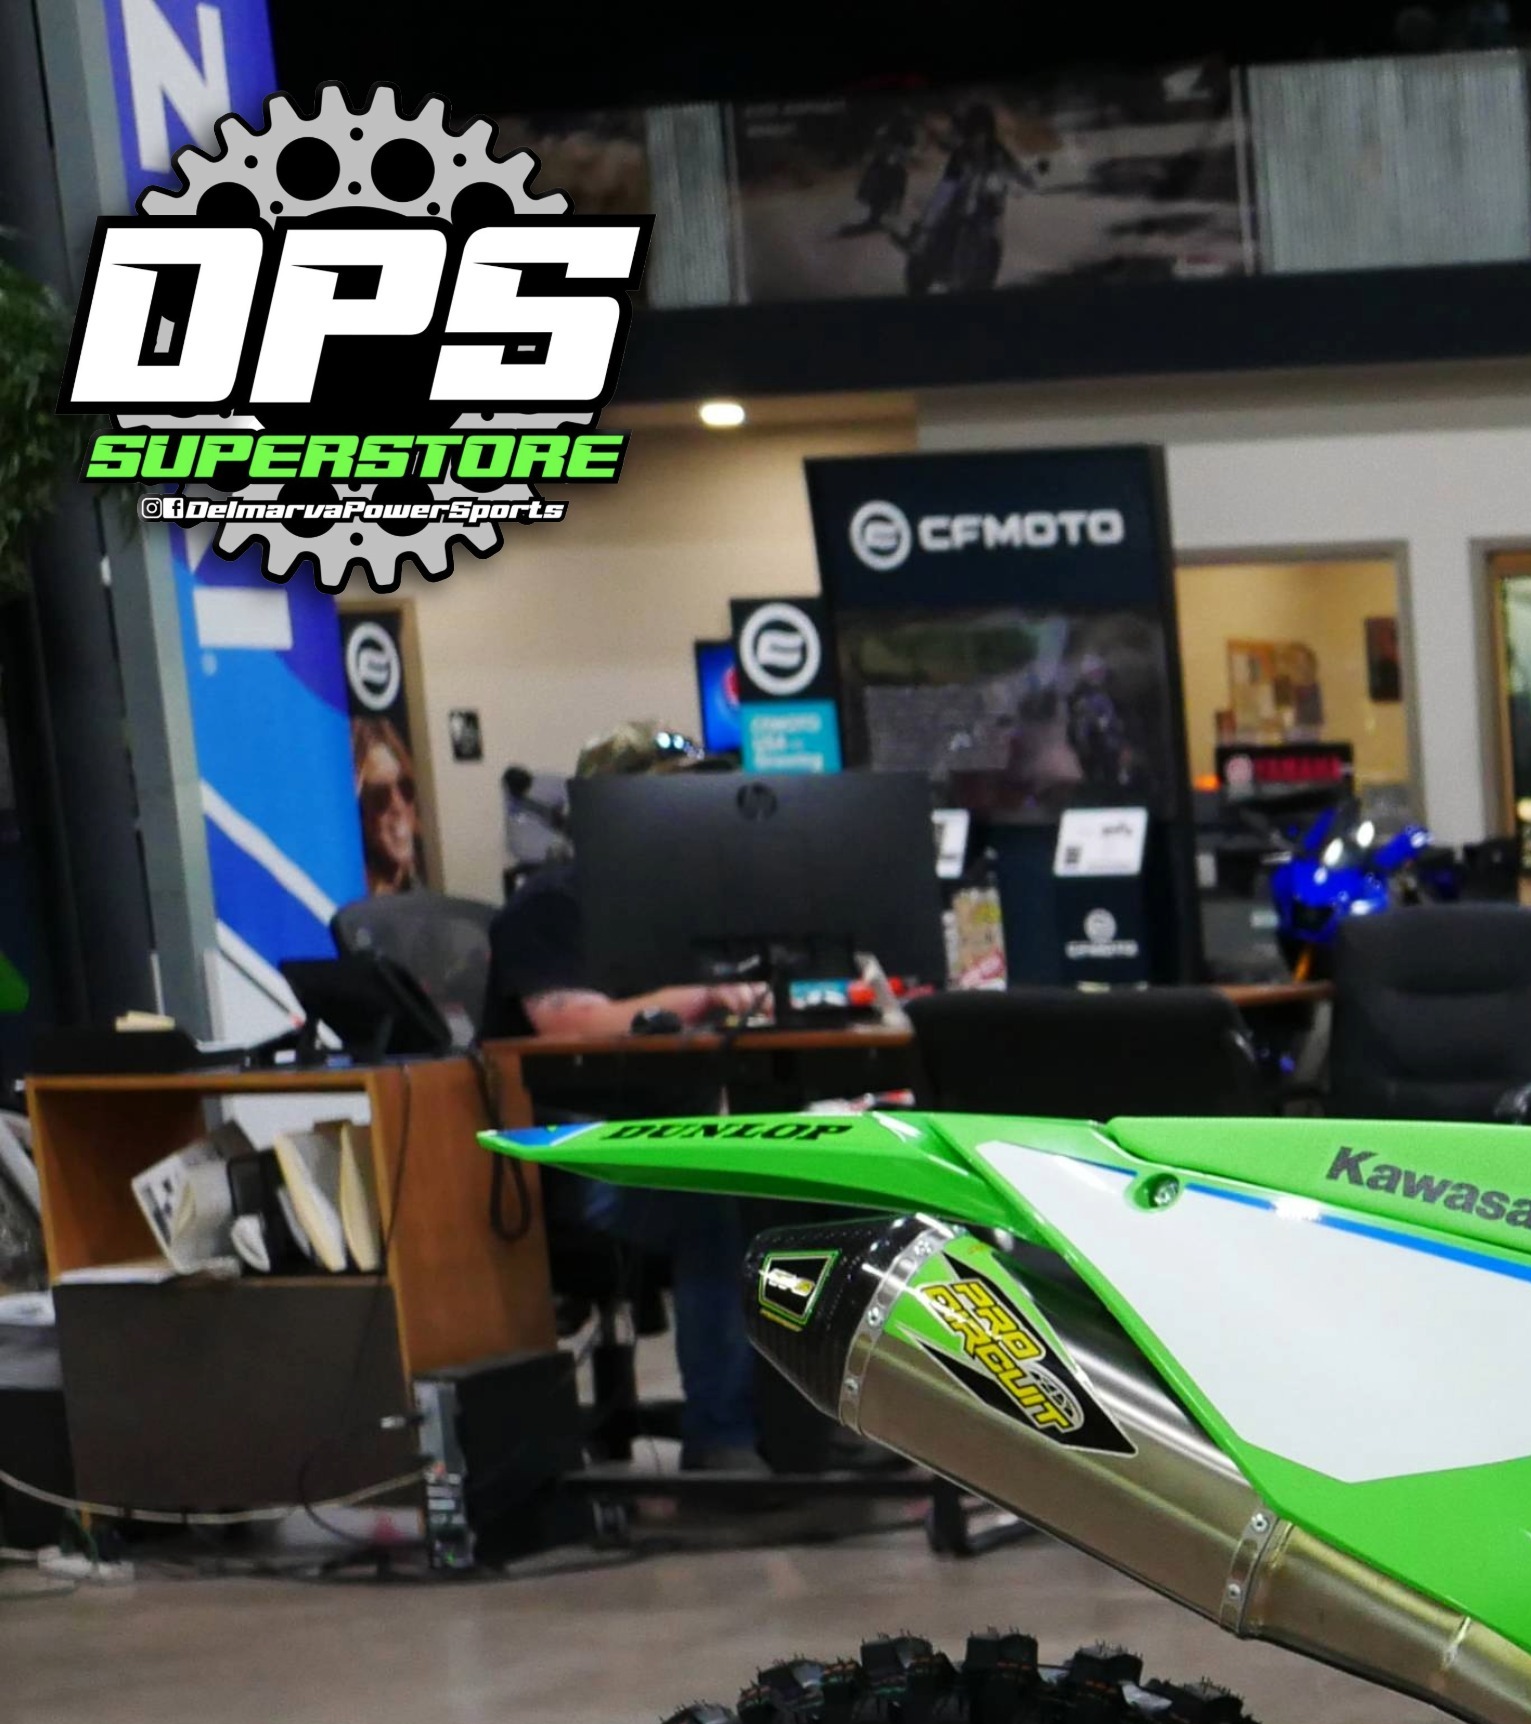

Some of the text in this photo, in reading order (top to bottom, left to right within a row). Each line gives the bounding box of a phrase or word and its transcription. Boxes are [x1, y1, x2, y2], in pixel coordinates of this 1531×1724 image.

[918, 508, 1124, 551] CFMOTO
[601, 1122, 853, 1141] DUNLOP
[953, 1282, 1041, 1361] PRO
[921, 1284, 1075, 1433] CIRCUIT
